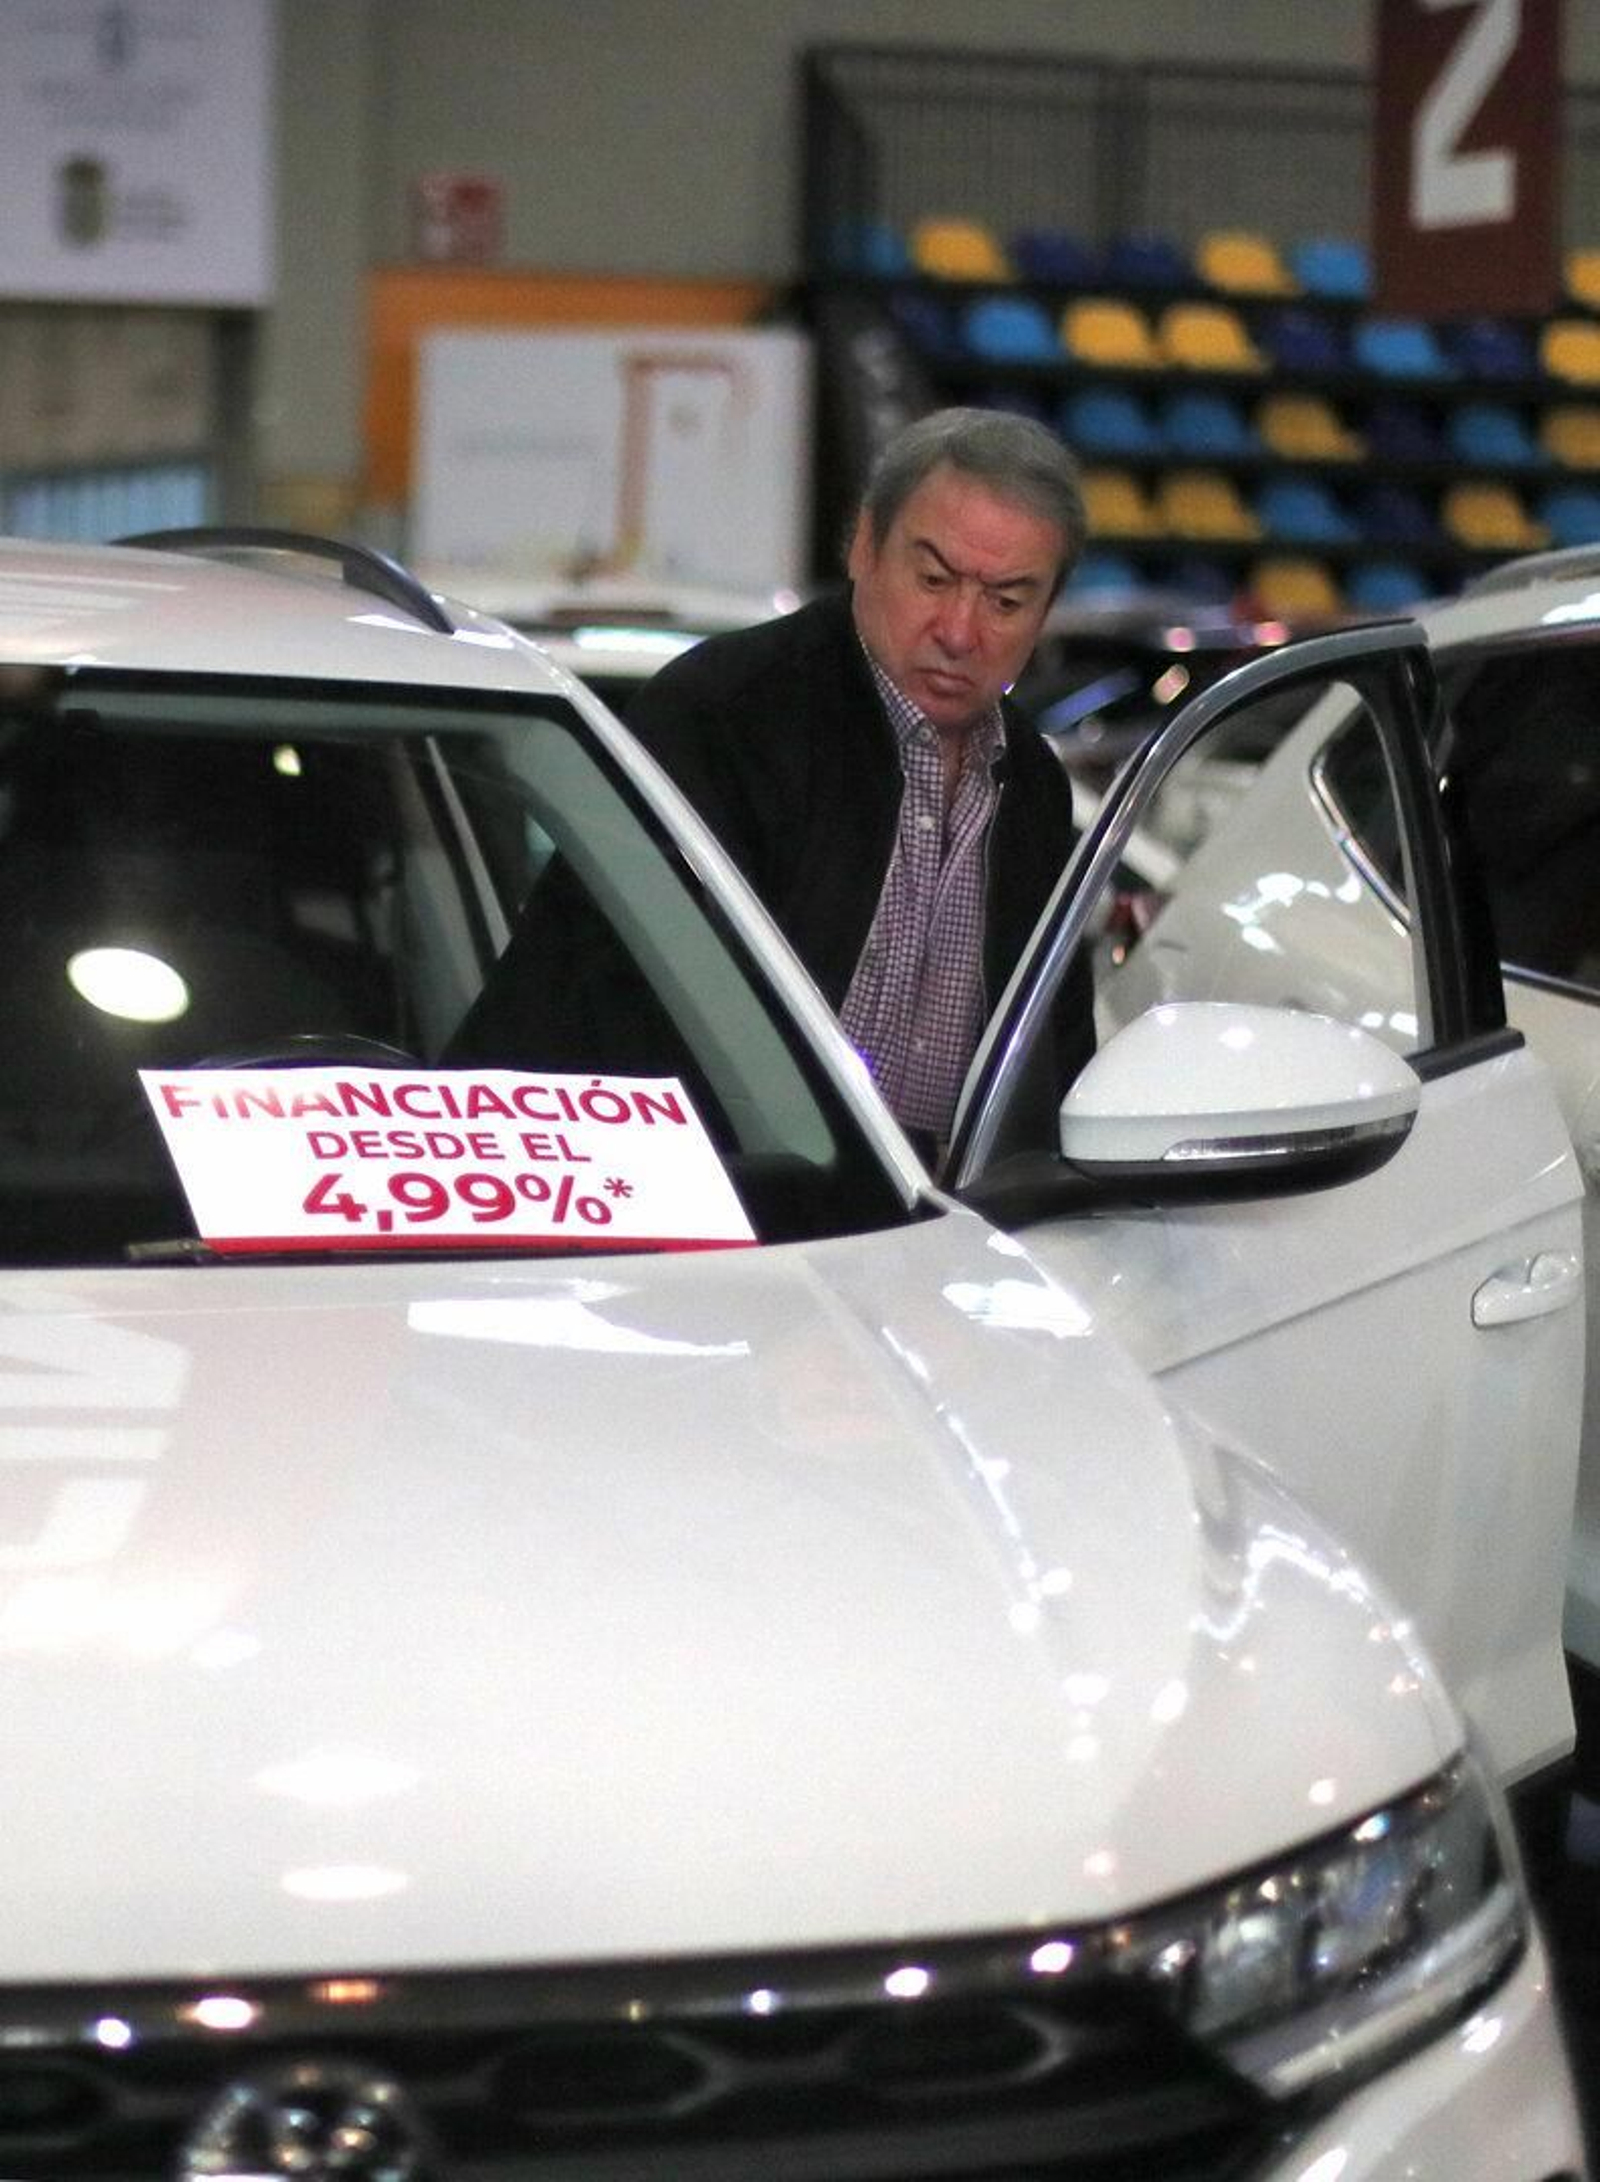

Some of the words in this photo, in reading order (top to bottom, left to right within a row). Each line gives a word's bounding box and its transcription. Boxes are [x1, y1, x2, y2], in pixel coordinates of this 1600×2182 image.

[1411, 0, 1520, 230] 2
[159, 1079, 688, 1125] FINANCIACIÓN
[305, 1130, 506, 1161] DESDE
[518, 1132, 593, 1163] EL
